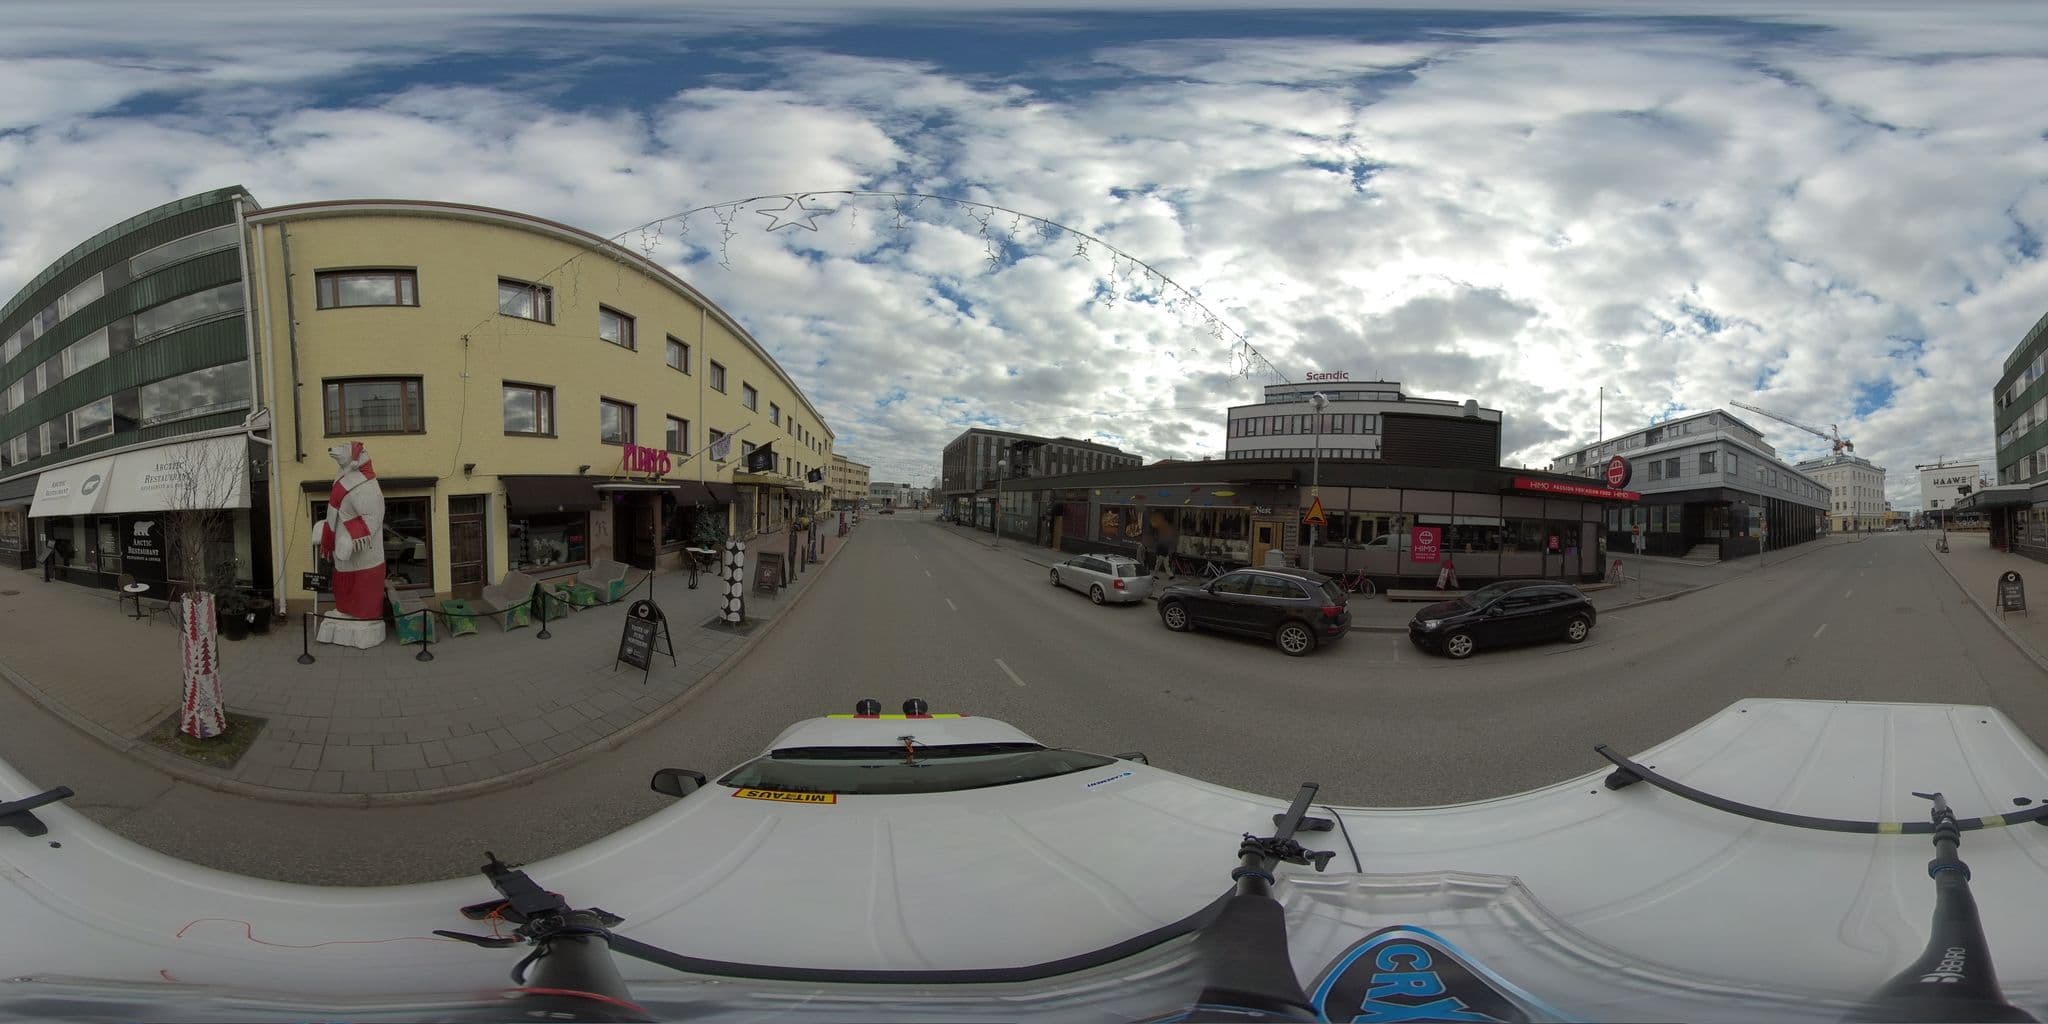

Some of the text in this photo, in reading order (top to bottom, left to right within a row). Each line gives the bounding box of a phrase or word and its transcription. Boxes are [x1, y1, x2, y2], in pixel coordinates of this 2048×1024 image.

[1306, 371, 1349, 381] Scandic
[1530, 481, 1550, 490] HIMO
[1553, 484, 1574, 492] PASSION
[747, 791, 825, 801] MITTAUS
